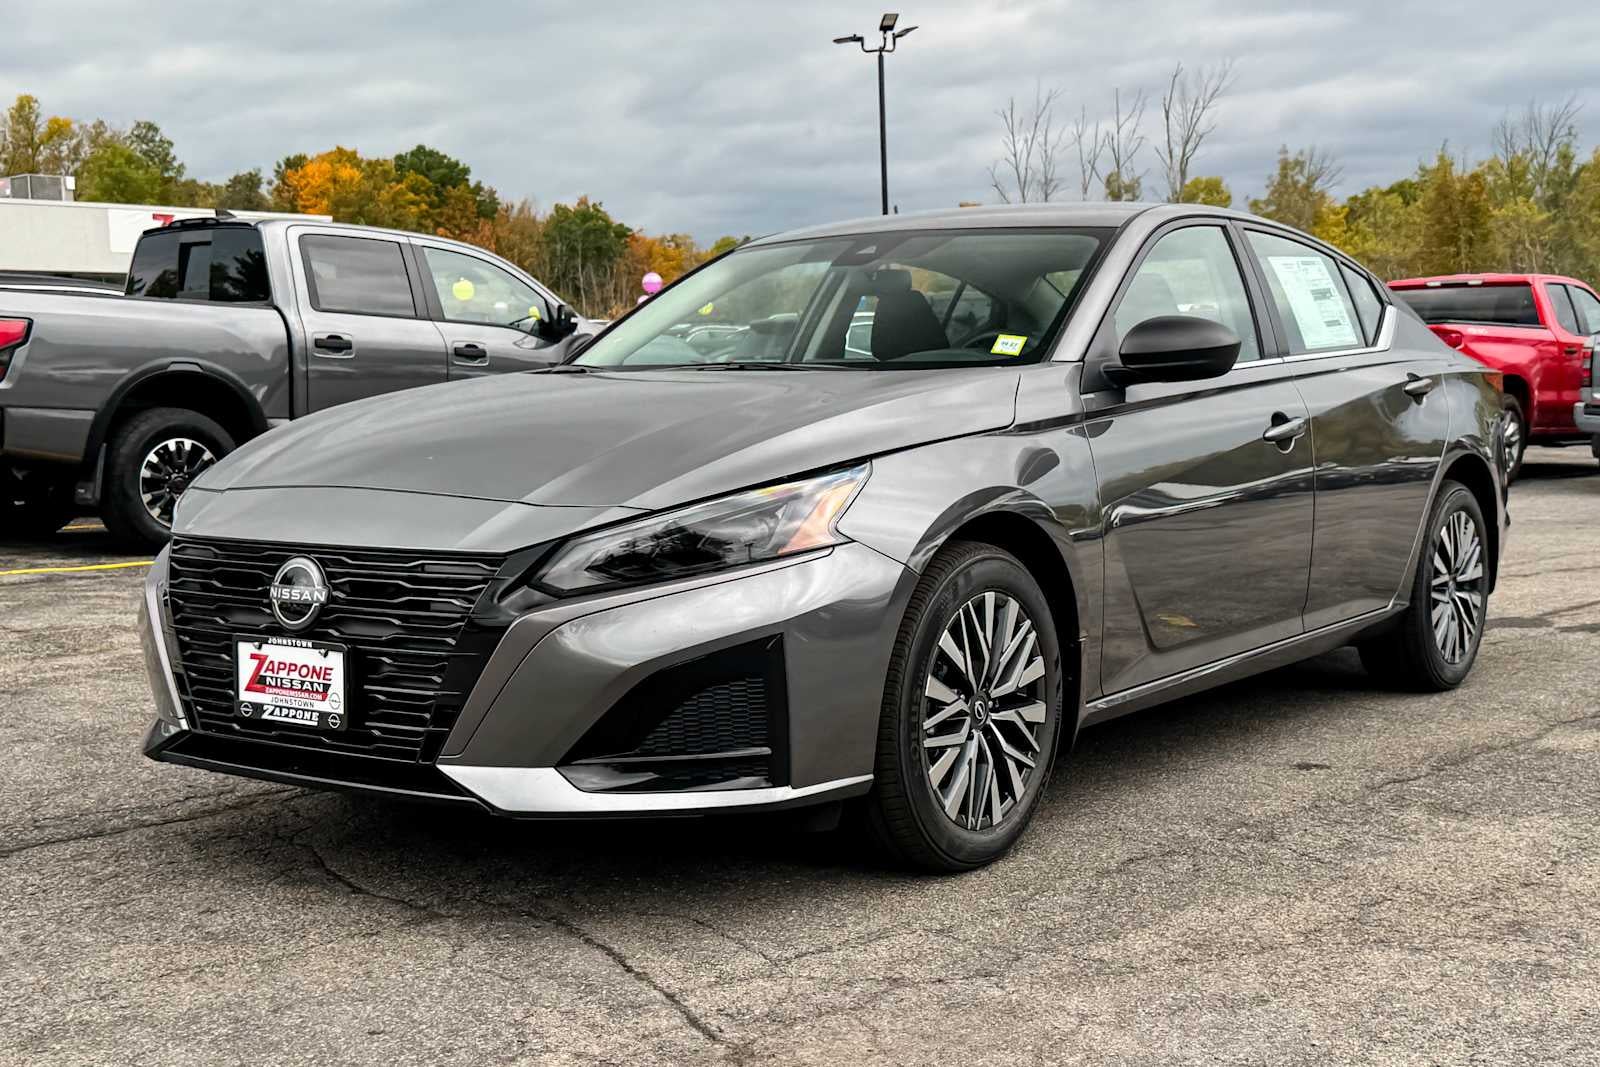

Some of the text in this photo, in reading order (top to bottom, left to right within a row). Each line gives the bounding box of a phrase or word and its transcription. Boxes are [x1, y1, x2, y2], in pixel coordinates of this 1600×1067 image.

[270, 587, 326, 601] NISSAN
[267, 637, 313, 648] JOHNSTOWN
[244, 653, 334, 691] ZAPPONE
[265, 677, 324, 693] NISSAN
[271, 697, 315, 709] JOHNSTOWN
[262, 705, 320, 725] ZAPPONE
